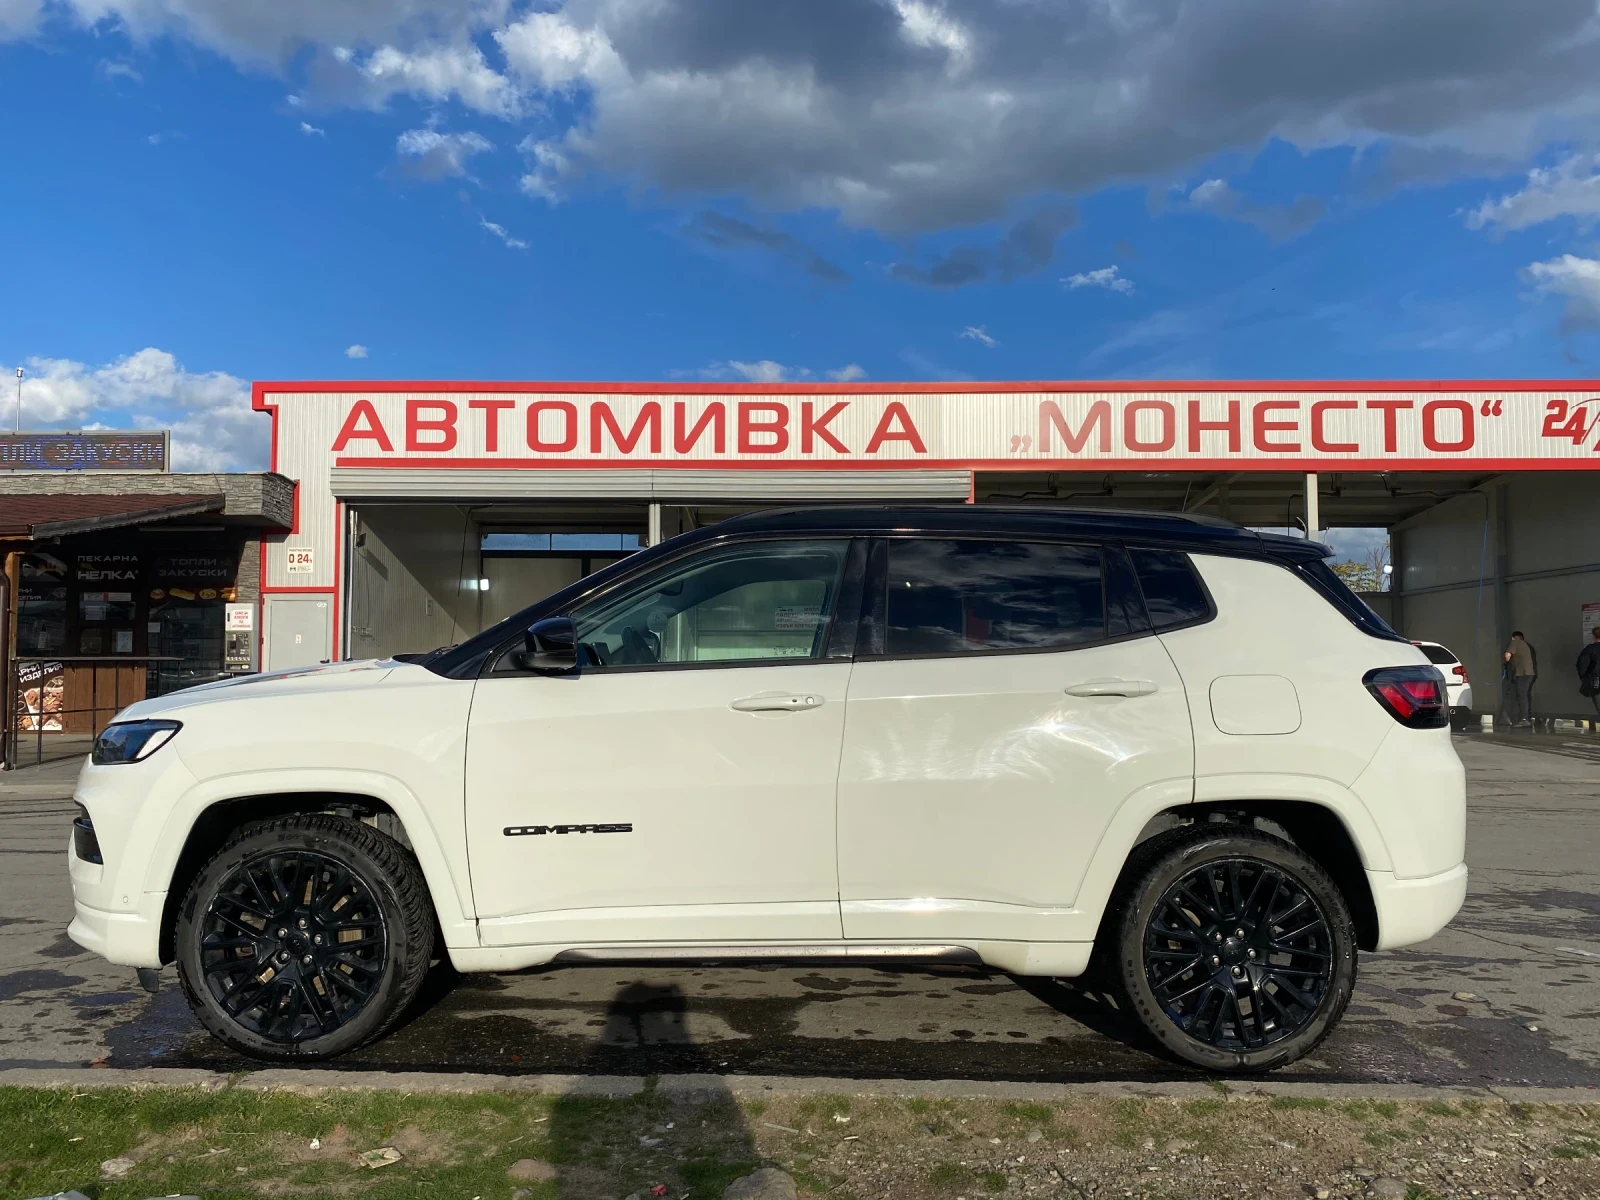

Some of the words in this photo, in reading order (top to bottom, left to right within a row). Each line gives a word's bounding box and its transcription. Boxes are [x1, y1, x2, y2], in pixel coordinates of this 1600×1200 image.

[331, 398, 928, 455] АВТОМИВКА
[54, 443, 163, 461] ЗАКУСКИ
[169, 558, 217, 566] ТОПЛИ
[77, 570, 137, 580] НЕЛКА
[159, 569, 227, 577] ЗАКУСКИ
[503, 823, 633, 836] COMPASS
